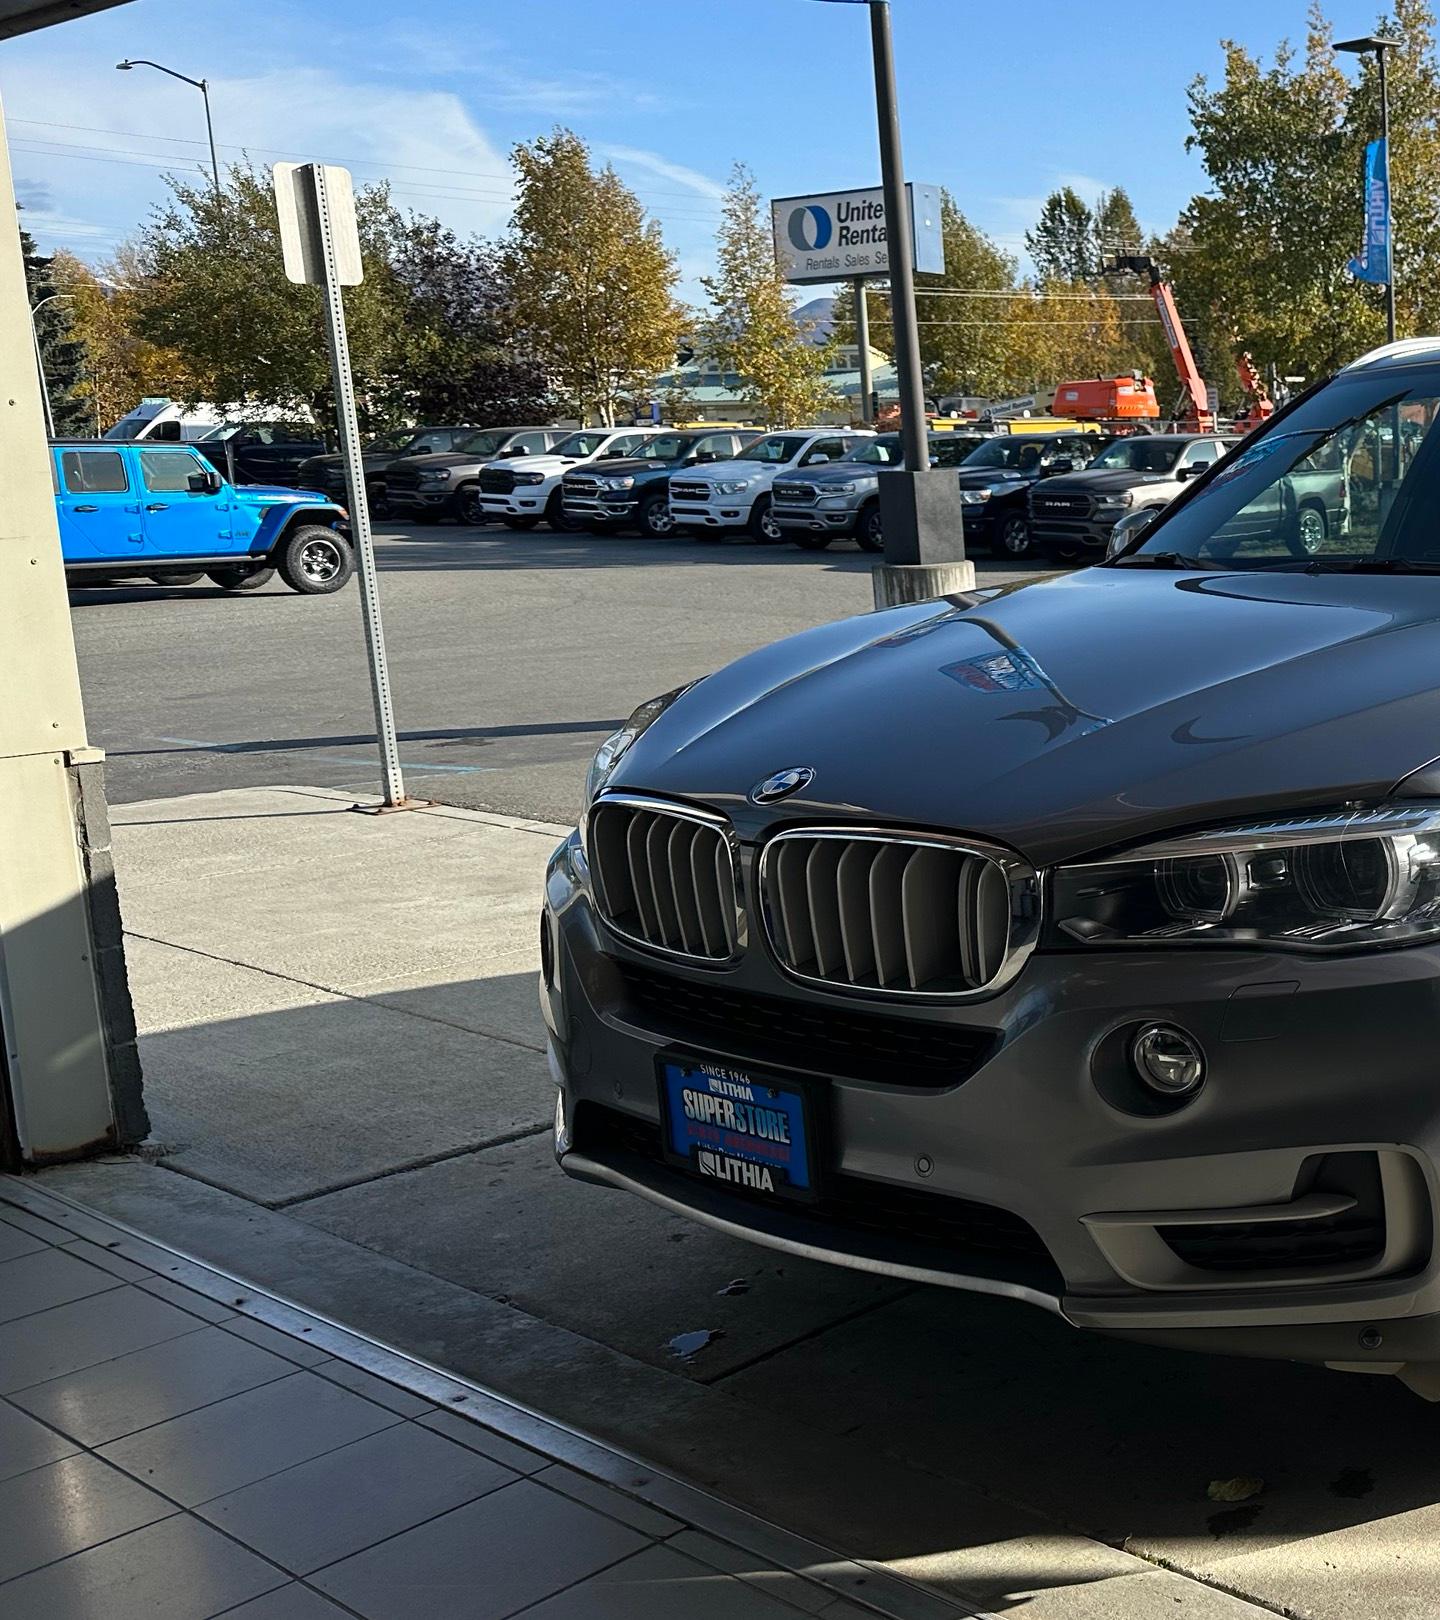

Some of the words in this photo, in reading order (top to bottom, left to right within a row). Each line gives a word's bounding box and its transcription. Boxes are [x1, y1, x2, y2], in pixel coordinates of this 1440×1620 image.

[836, 200, 884, 223] Unite
[838, 223, 888, 247] Renta
[806, 253, 840, 271] Rentals
[844, 252, 870, 268] Sales
[700, 1064, 726, 1079] SINCE
[728, 1070, 751, 1085] 1946
[718, 1080, 754, 1101] LITHIA
[682, 1088, 791, 1144] SUPERSTORE
[714, 1153, 775, 1193] LITHIA
